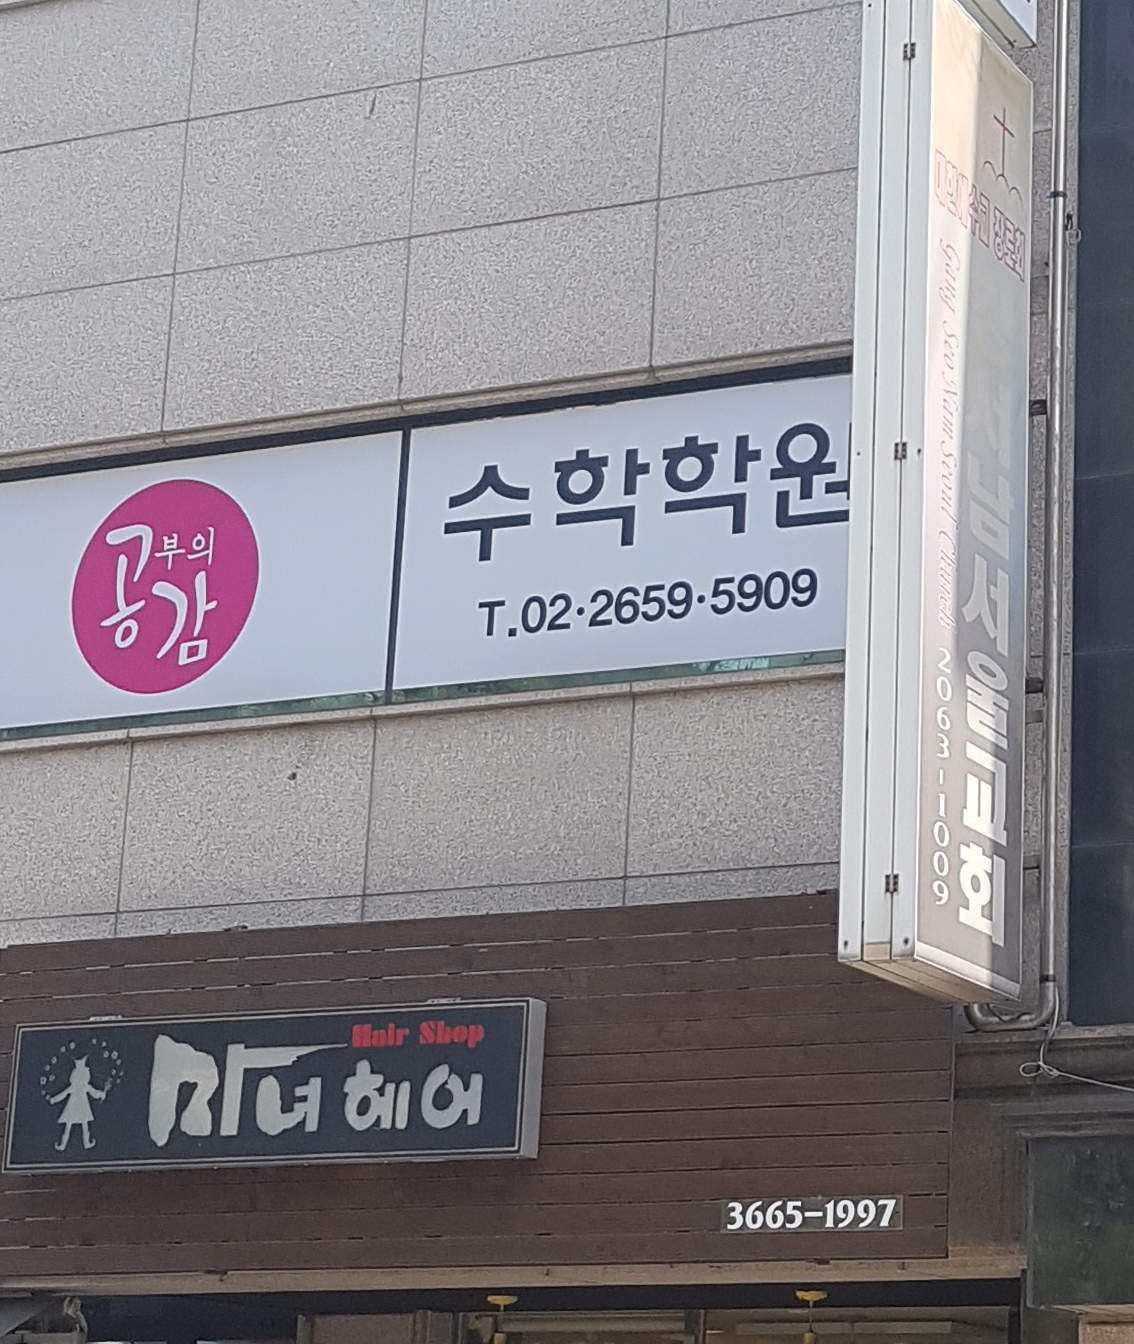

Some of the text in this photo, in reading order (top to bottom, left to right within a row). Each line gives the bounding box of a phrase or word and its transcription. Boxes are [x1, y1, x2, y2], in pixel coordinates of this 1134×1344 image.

[444, 422, 850, 562] 수학학원
[352, 1020, 485, 1049] Hair Shop
[726, 1199, 896, 1230] 3665-1997
